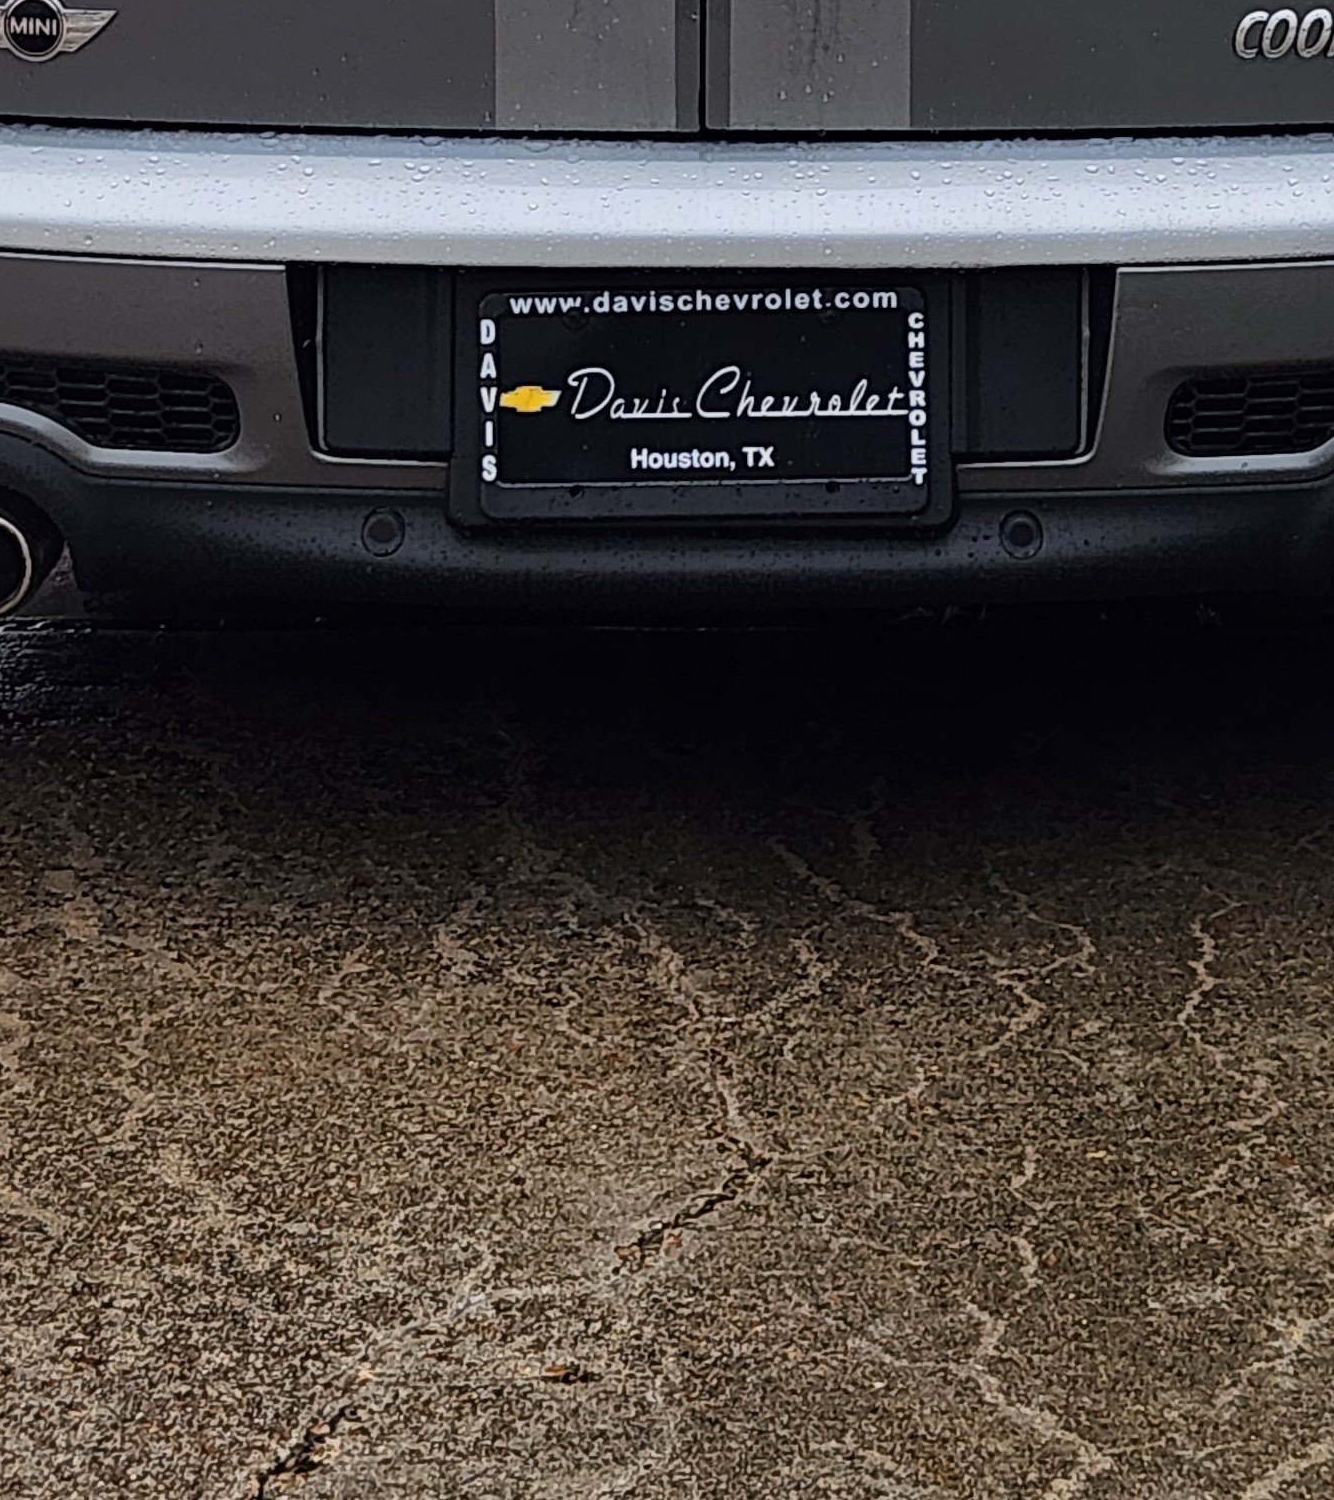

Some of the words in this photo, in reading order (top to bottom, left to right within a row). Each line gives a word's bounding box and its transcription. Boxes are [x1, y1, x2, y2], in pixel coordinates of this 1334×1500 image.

[10, 15, 57, 36] MINI
[509, 289, 898, 314] www.davischevrolet.com
[479, 318, 498, 483] DAVIS
[567, 366, 693, 420] Davis
[695, 365, 909, 419] Chevrolet
[906, 311, 928, 486] CHEVROLET
[630, 447, 737, 471] Houston,
[742, 446, 775, 468] TX
